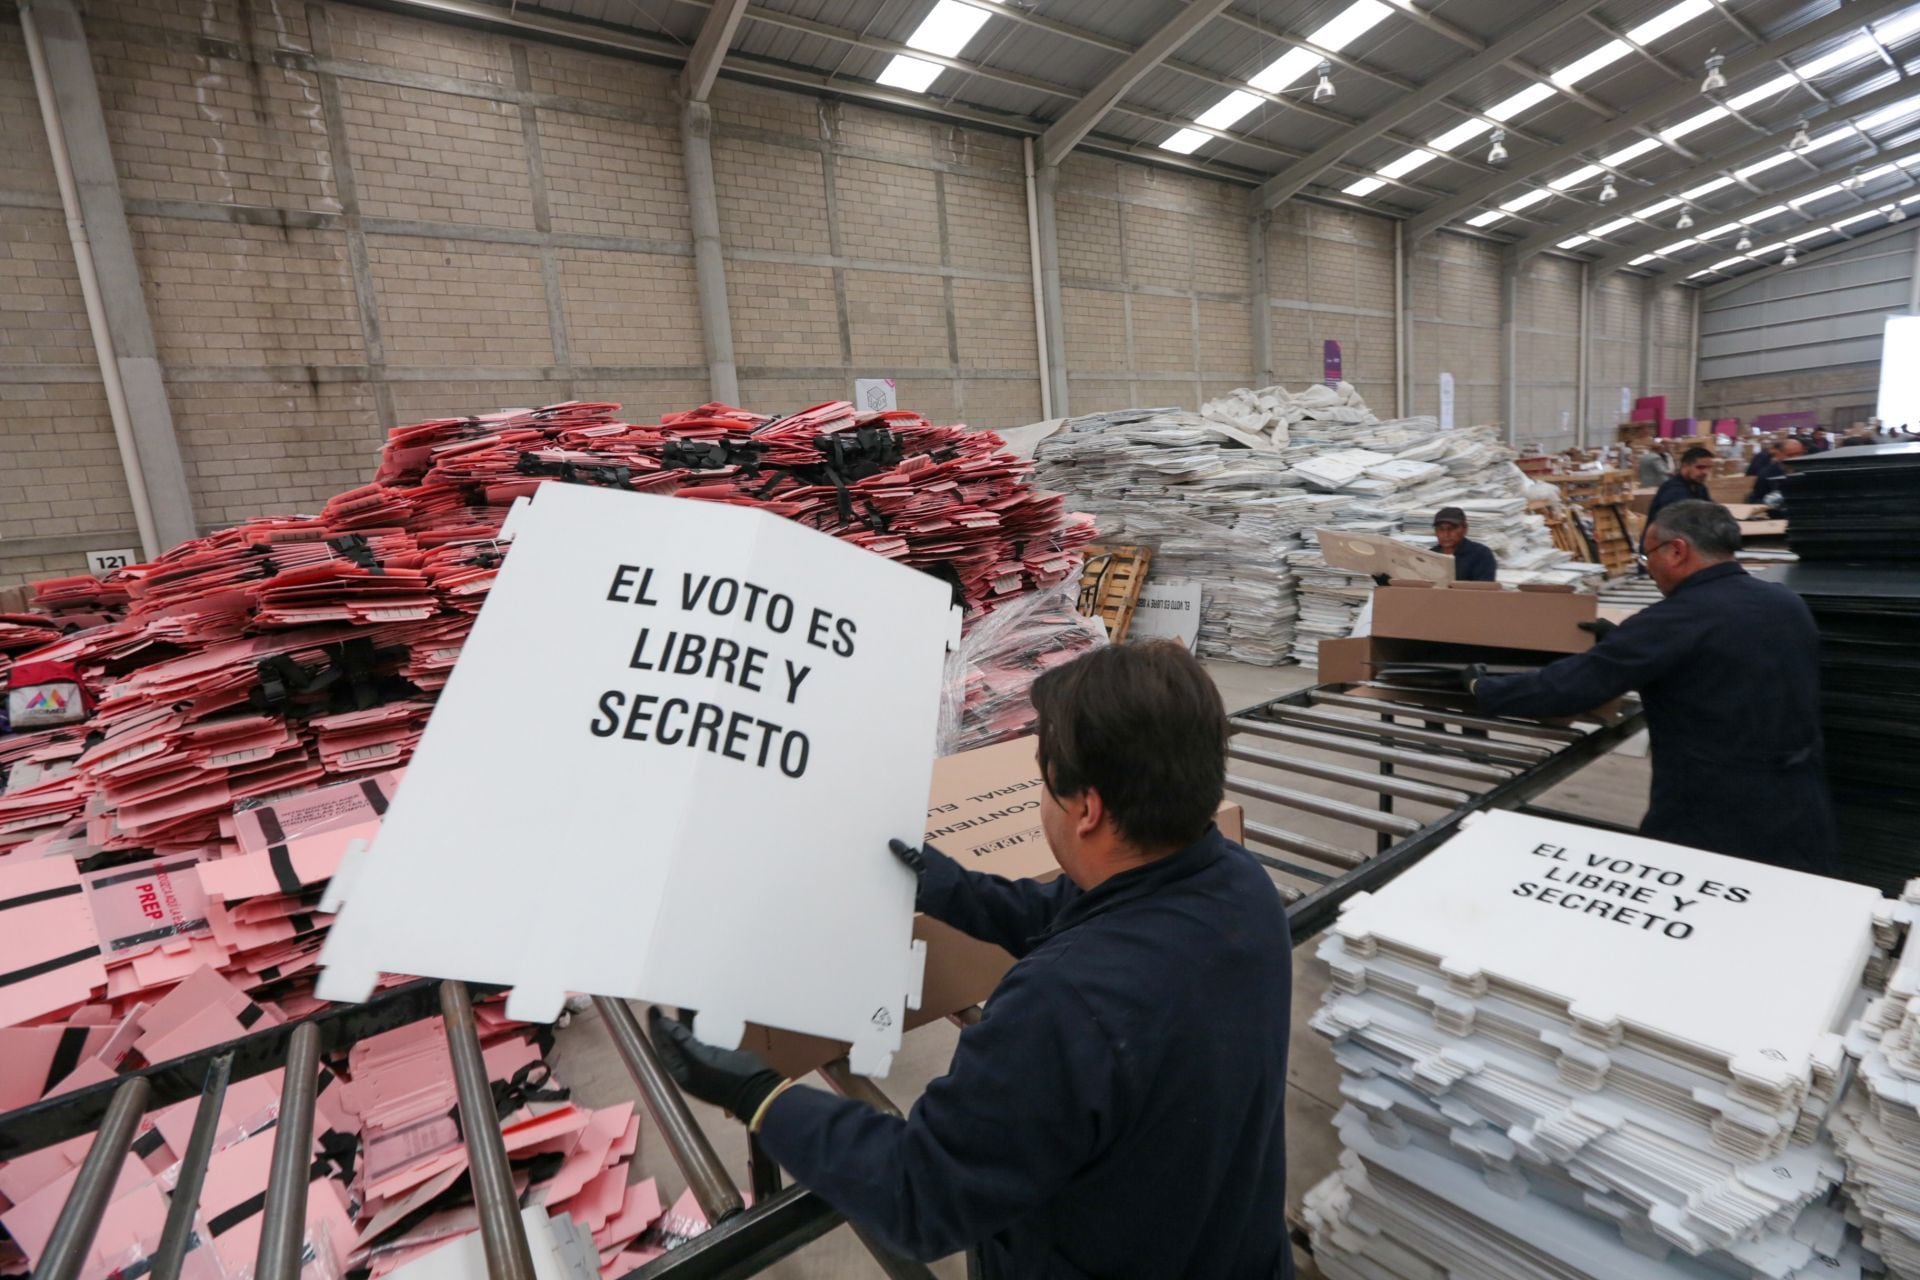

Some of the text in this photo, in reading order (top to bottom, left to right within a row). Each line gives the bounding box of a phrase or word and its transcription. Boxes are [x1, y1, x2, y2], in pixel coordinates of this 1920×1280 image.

[96, 555, 127, 569] 121
[606, 564, 857, 658] EL VOTO ES
[629, 628, 811, 704] LIBRE Y
[590, 690, 810, 779] SECRETO
[928, 778, 1044, 818] TERIAL EL
[924, 801, 1041, 843] CONTIENE
[972, 835, 1025, 857] IEEM
[1531, 843, 1752, 904] EL VOTO ES
[1544, 866, 1698, 913] LIBRE Y
[135, 883, 163, 919] PREP
[1512, 881, 1695, 941] SECRETO
